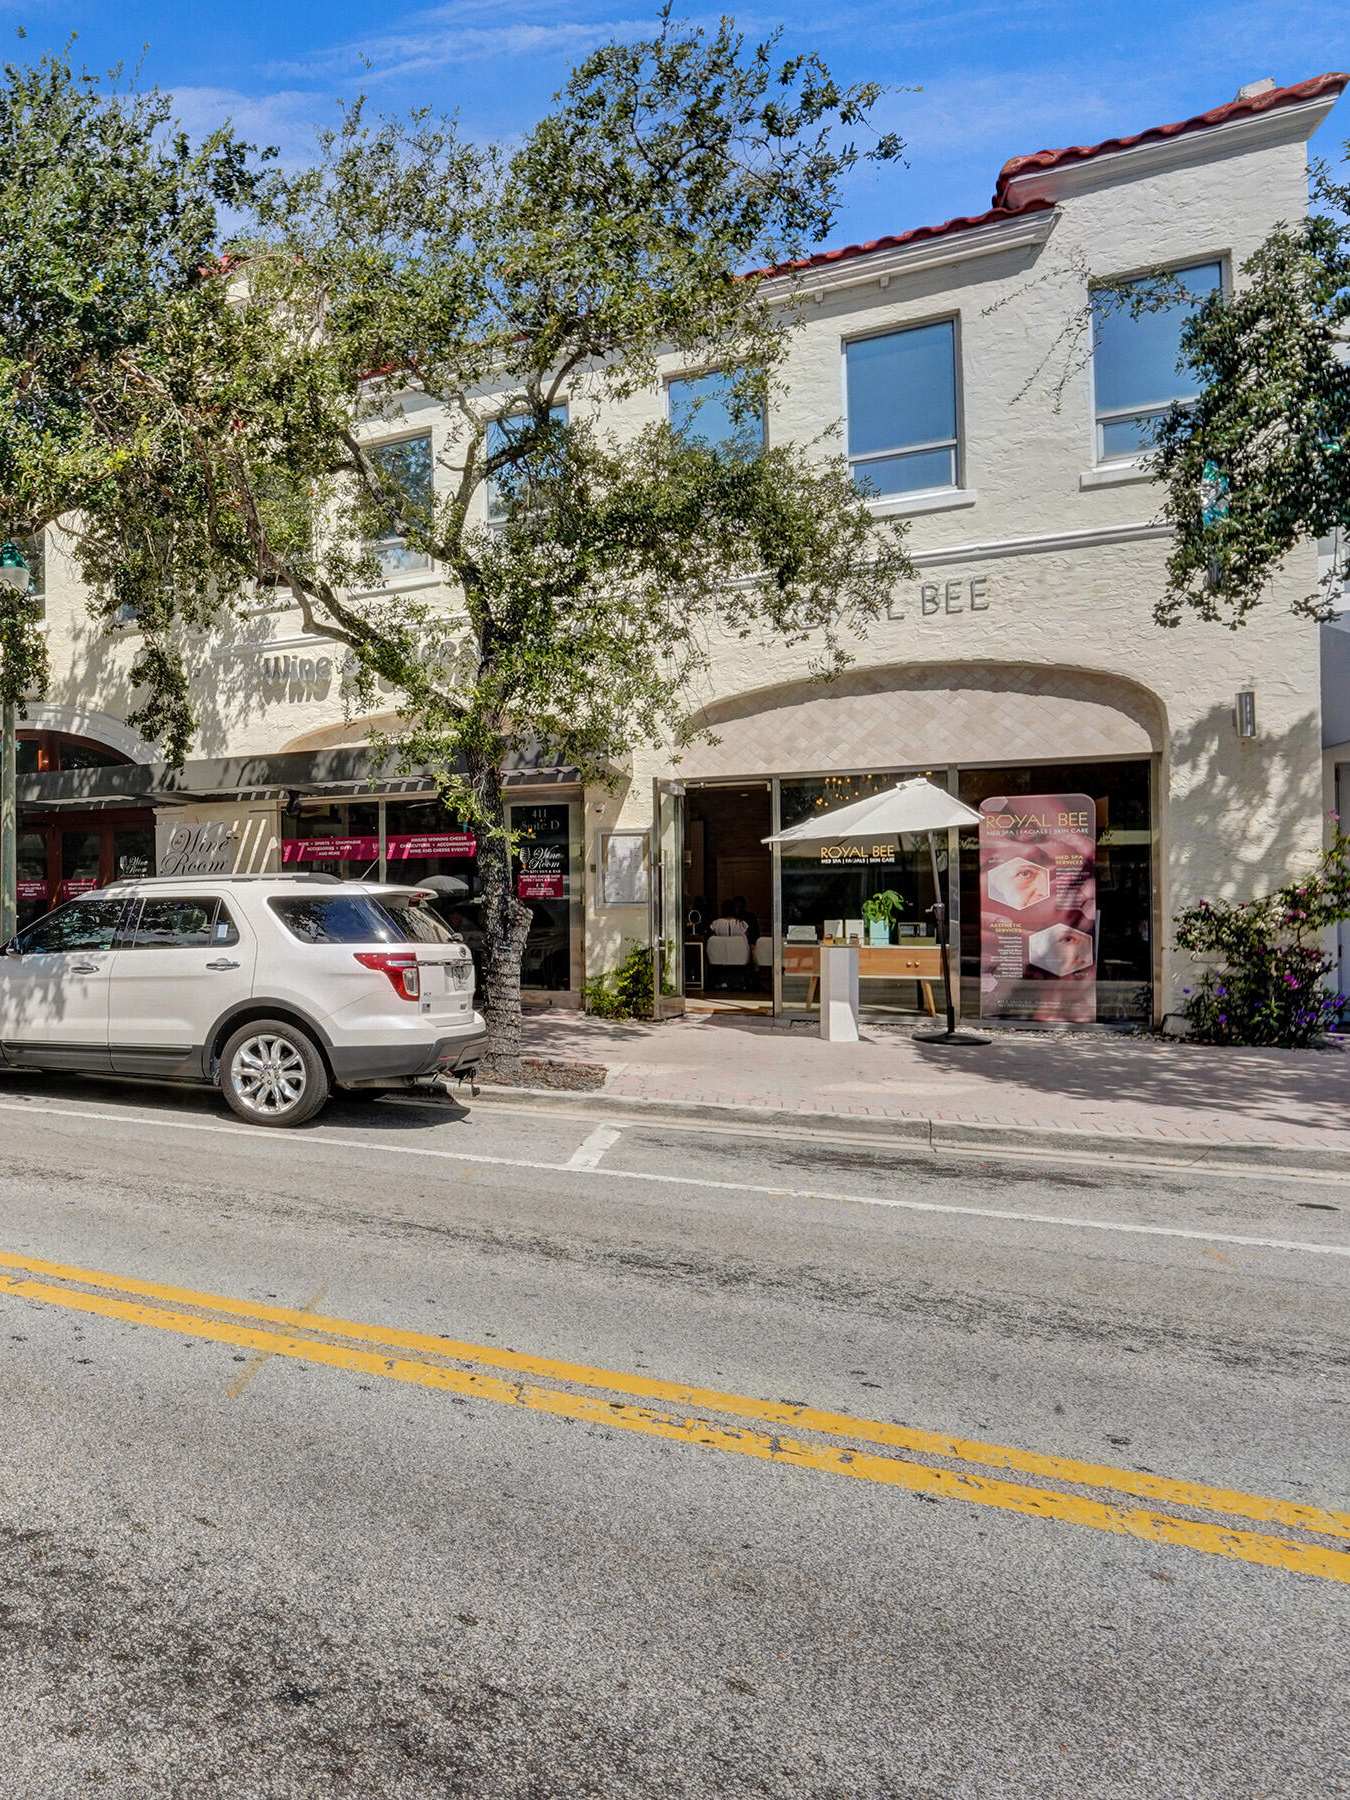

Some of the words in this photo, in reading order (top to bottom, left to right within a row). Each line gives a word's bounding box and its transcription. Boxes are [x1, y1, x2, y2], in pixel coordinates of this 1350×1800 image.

[921, 575, 990, 616] BEE
[262, 655, 333, 682] Wine
[531, 808, 548, 819] 411
[986, 813, 1051, 829] ROYAL
[1058, 812, 1089, 827] BEE
[550, 820, 560, 830] D
[171, 822, 229, 854] Wine
[533, 844, 561, 860] Wine
[820, 846, 869, 859] ROYAL
[872, 845, 895, 858] BEE
[160, 851, 228, 875] Room
[529, 859, 560, 869] Room
